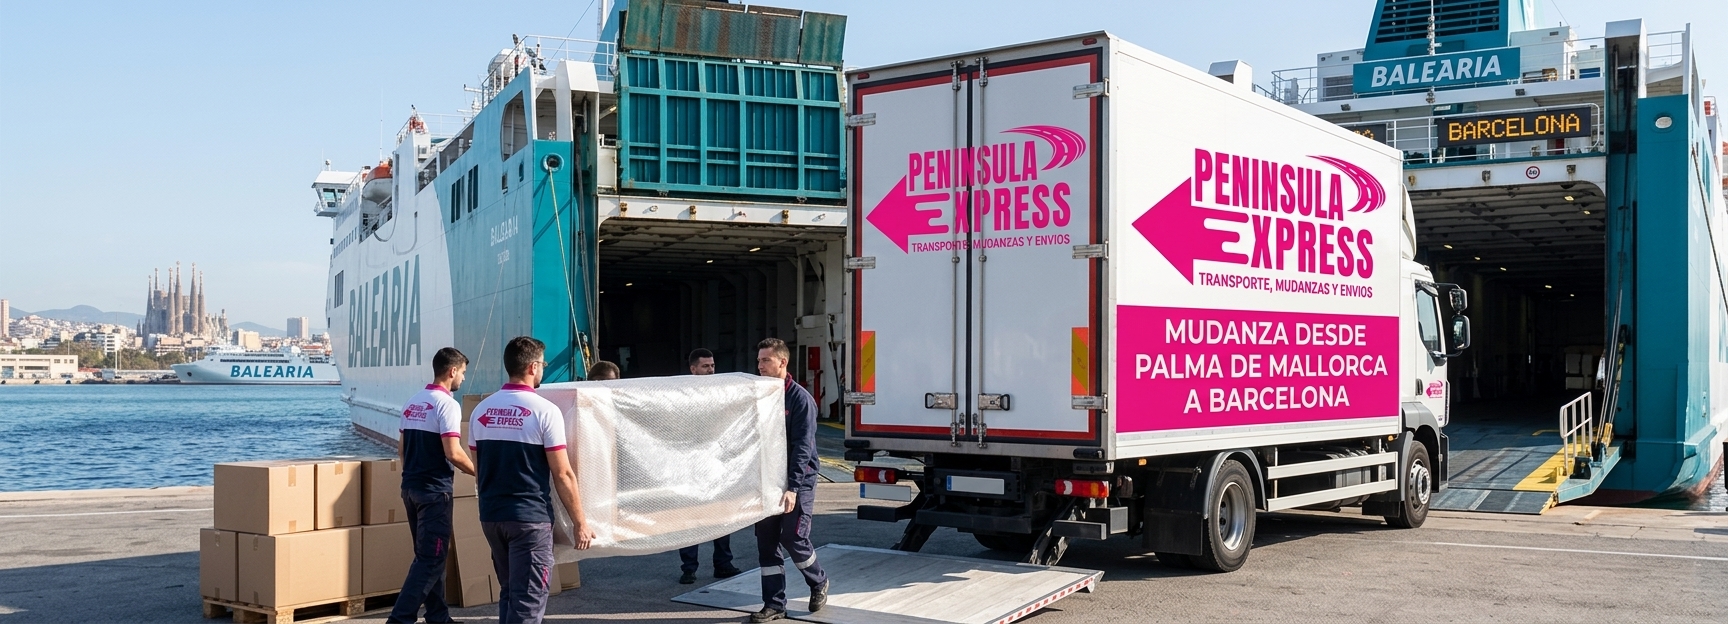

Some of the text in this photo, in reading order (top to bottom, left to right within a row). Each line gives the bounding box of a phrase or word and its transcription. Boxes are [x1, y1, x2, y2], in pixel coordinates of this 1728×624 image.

[1449, 113, 1581, 142] BARCELONA
[909, 141, 1038, 192] PENINSULA
[1195, 148, 1344, 222] PENINSULA
[1026, 235, 1033, 246] Y
[1035, 233, 1071, 246] ENVIOS
[1199, 272, 1373, 298] TRANSPORTE, MUDANZAS Y ENVIOS
[1165, 319, 1366, 346] MUDANZA DESDE
[1135, 354, 1388, 379] PALMA DE MALLORCA
[1183, 385, 1350, 414] A BARCELONA
